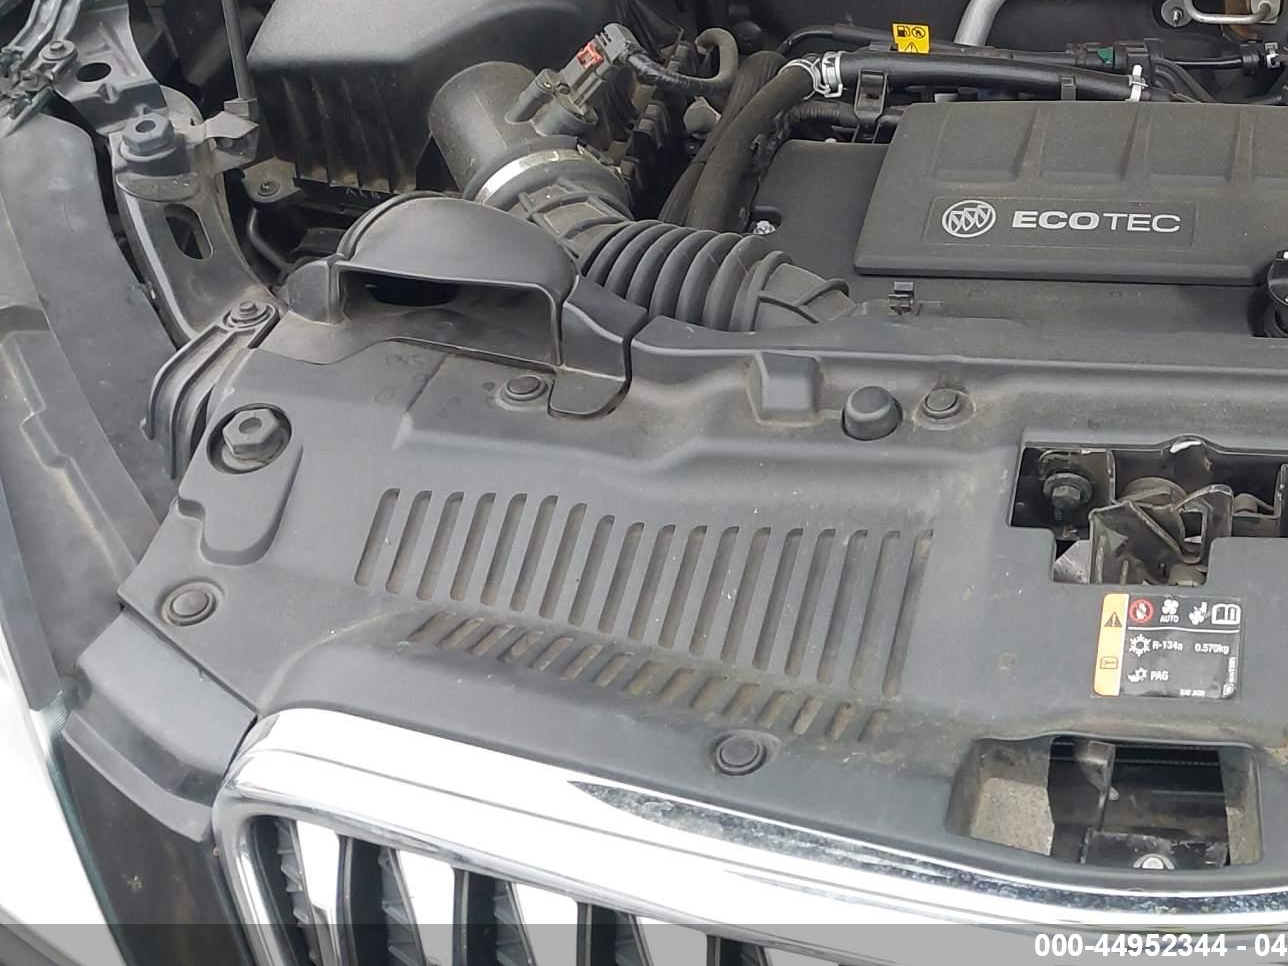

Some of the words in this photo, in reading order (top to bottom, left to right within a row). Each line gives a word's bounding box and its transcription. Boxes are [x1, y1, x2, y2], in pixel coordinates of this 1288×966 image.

[1012, 210, 1181, 233] ECOTEC
[1160, 615, 1179, 623] AUTO
[1152, 640, 1183, 651] R-134a
[1150, 670, 1169, 681] PAG
